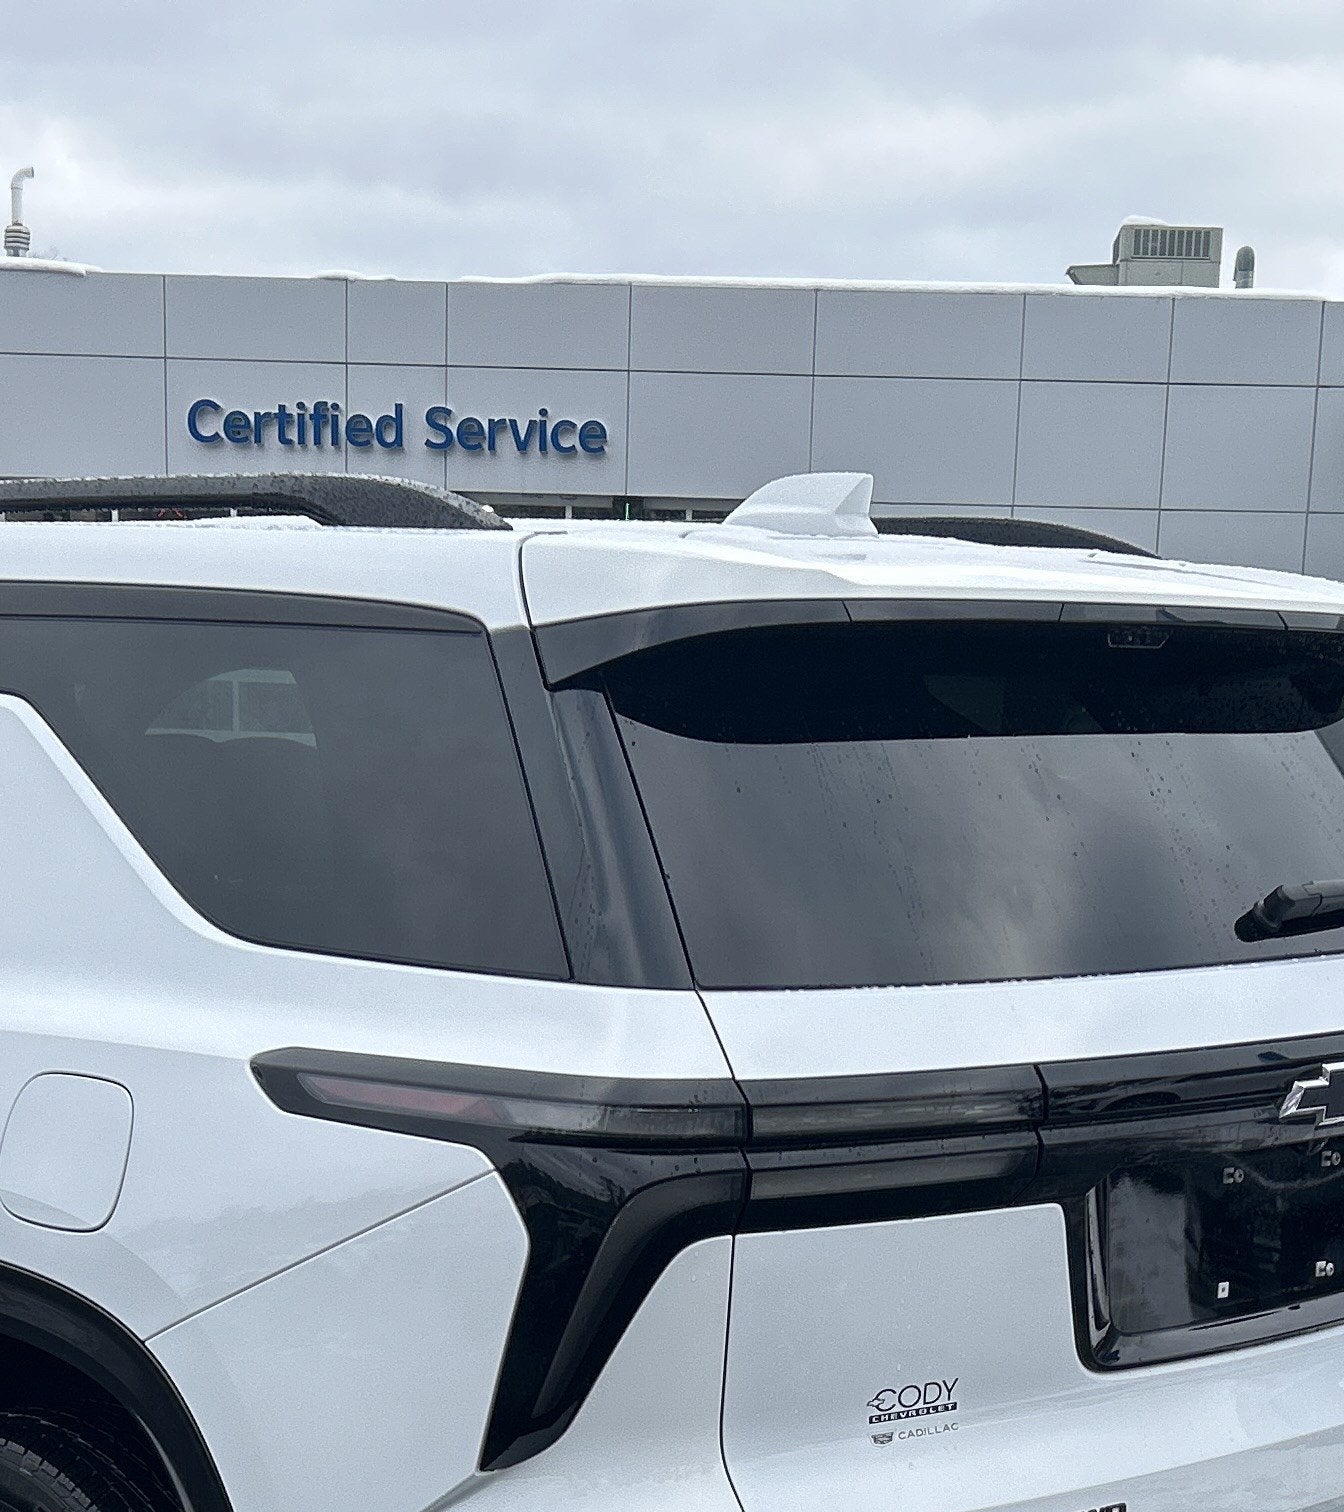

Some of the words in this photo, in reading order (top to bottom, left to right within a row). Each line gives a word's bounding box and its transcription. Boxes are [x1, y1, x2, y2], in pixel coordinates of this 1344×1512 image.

[187, 398, 404, 450] Certified
[424, 405, 608, 455] Service
[866, 1377, 959, 1412] CODY
[870, 1403, 956, 1423] CHEVROLET
[897, 1422, 959, 1440] CADILLAC
